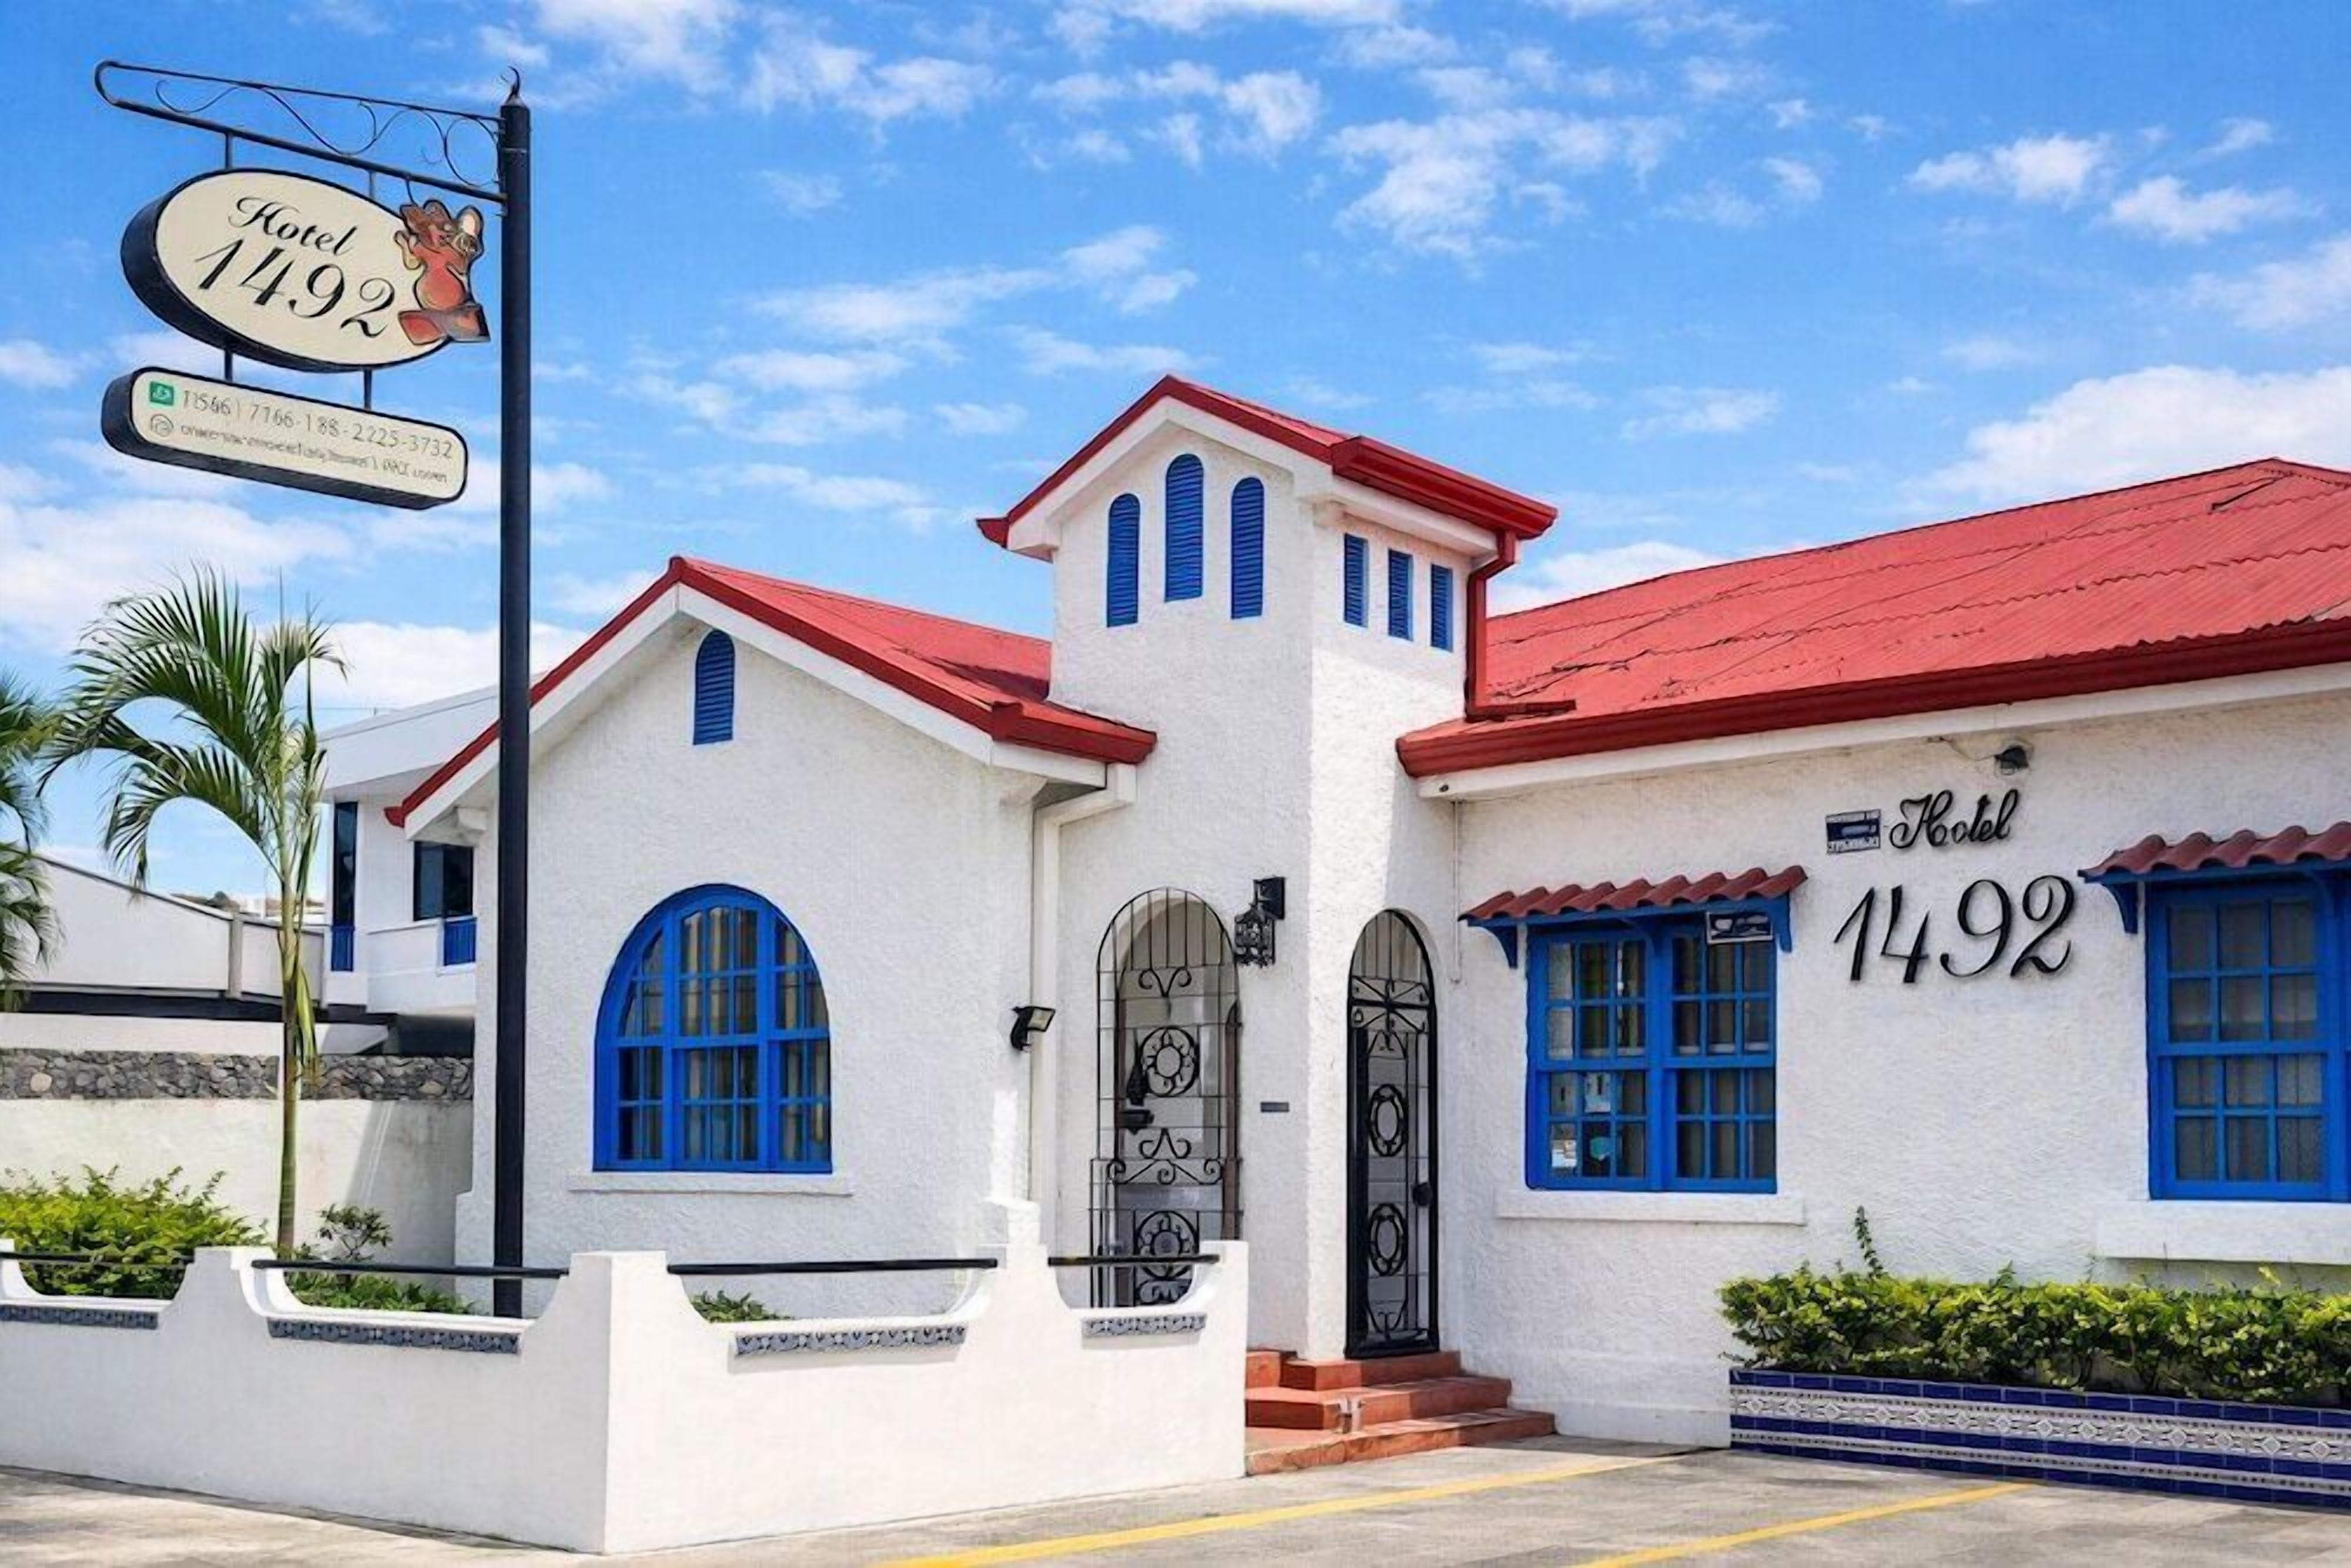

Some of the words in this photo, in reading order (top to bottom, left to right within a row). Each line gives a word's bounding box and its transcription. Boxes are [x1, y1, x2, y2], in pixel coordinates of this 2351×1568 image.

[228, 196, 358, 256] Hotel
[194, 238, 396, 339] 1492
[1889, 788, 2020, 850] Hotel
[1833, 875, 2077, 984] 1492
